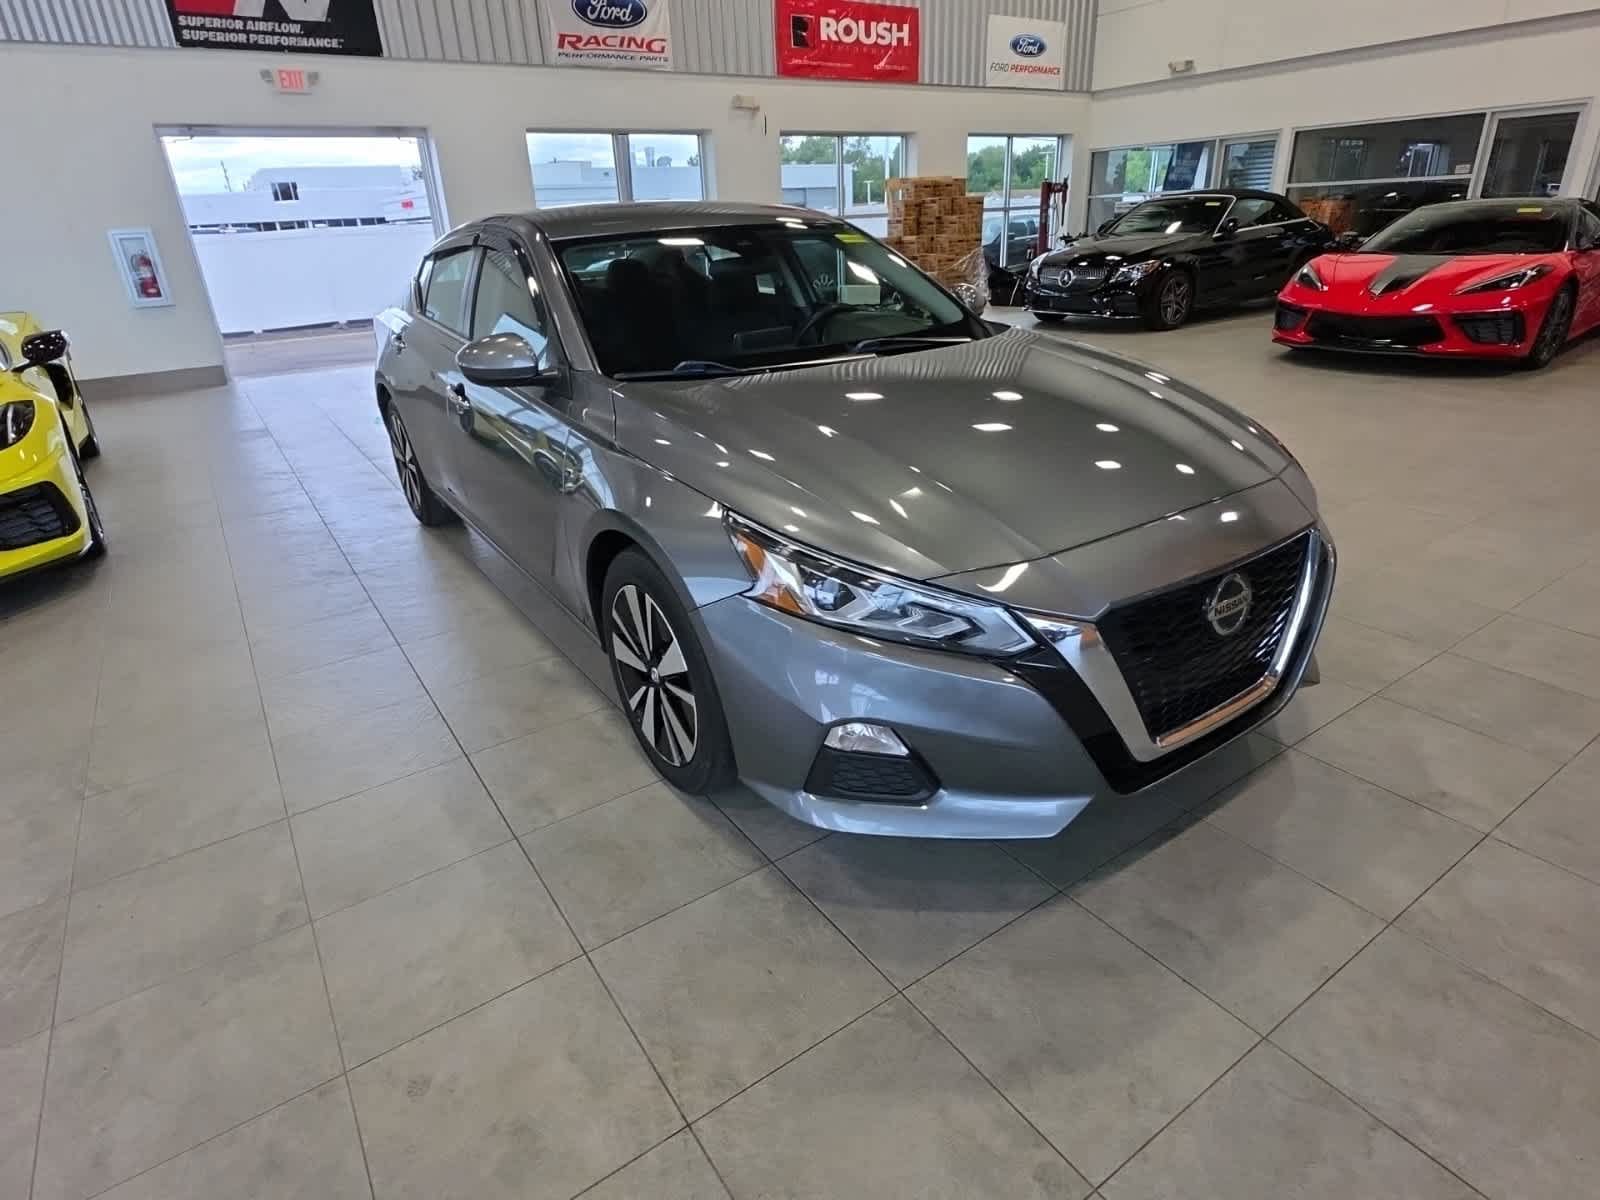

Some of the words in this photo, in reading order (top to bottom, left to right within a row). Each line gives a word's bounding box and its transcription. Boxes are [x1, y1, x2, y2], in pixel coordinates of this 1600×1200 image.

[587, 0, 633, 21] Ford
[178, 15, 244, 30] SUPERIOR
[246, 20, 304, 34] AIRFLOW.
[820, 16, 910, 47] ROUSH
[182, 29, 248, 44] SUPERIOR
[557, 33, 667, 54] RACING
[1016, 37, 1040, 54] Ford
[558, 52, 634, 61] PERFORMANCE
[990, 62, 1009, 73] FORD
[1009, 63, 1061, 76] PERFORMANCE
[278, 70, 304, 89] EXIT
[1213, 591, 1250, 617] NISSAN
